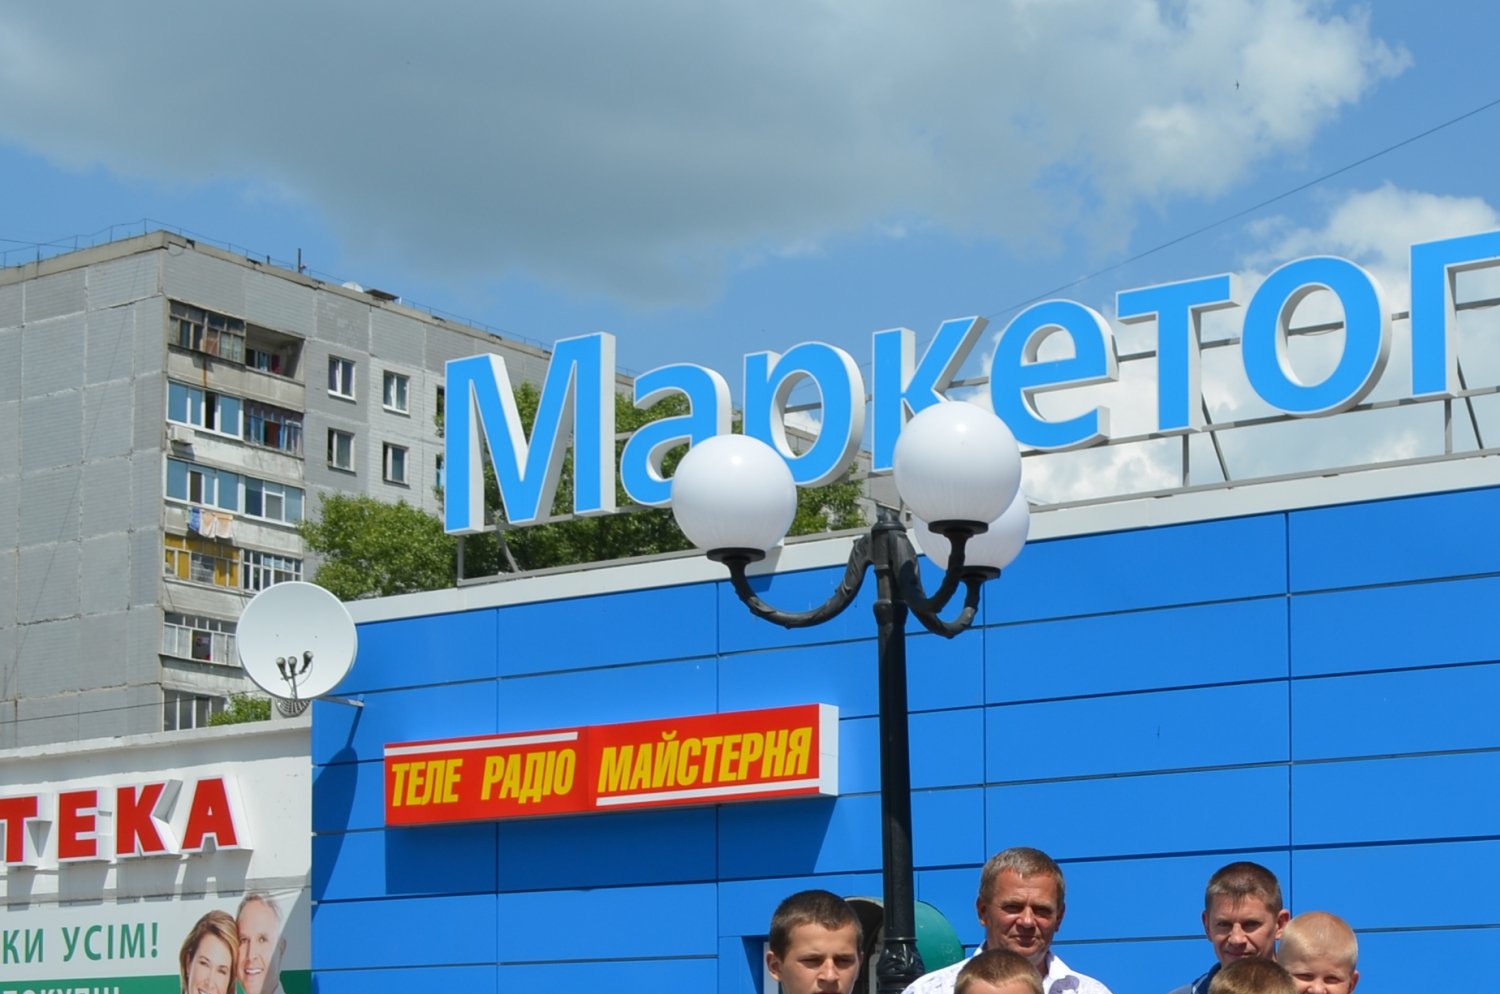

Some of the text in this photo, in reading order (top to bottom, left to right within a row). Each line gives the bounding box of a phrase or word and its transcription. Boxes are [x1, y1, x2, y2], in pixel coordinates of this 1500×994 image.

[391, 727, 814, 807] ТЕЛЕ РАДІО МАЙСТЕРНЯ
[61, 922, 158, 962] УСІМ!
